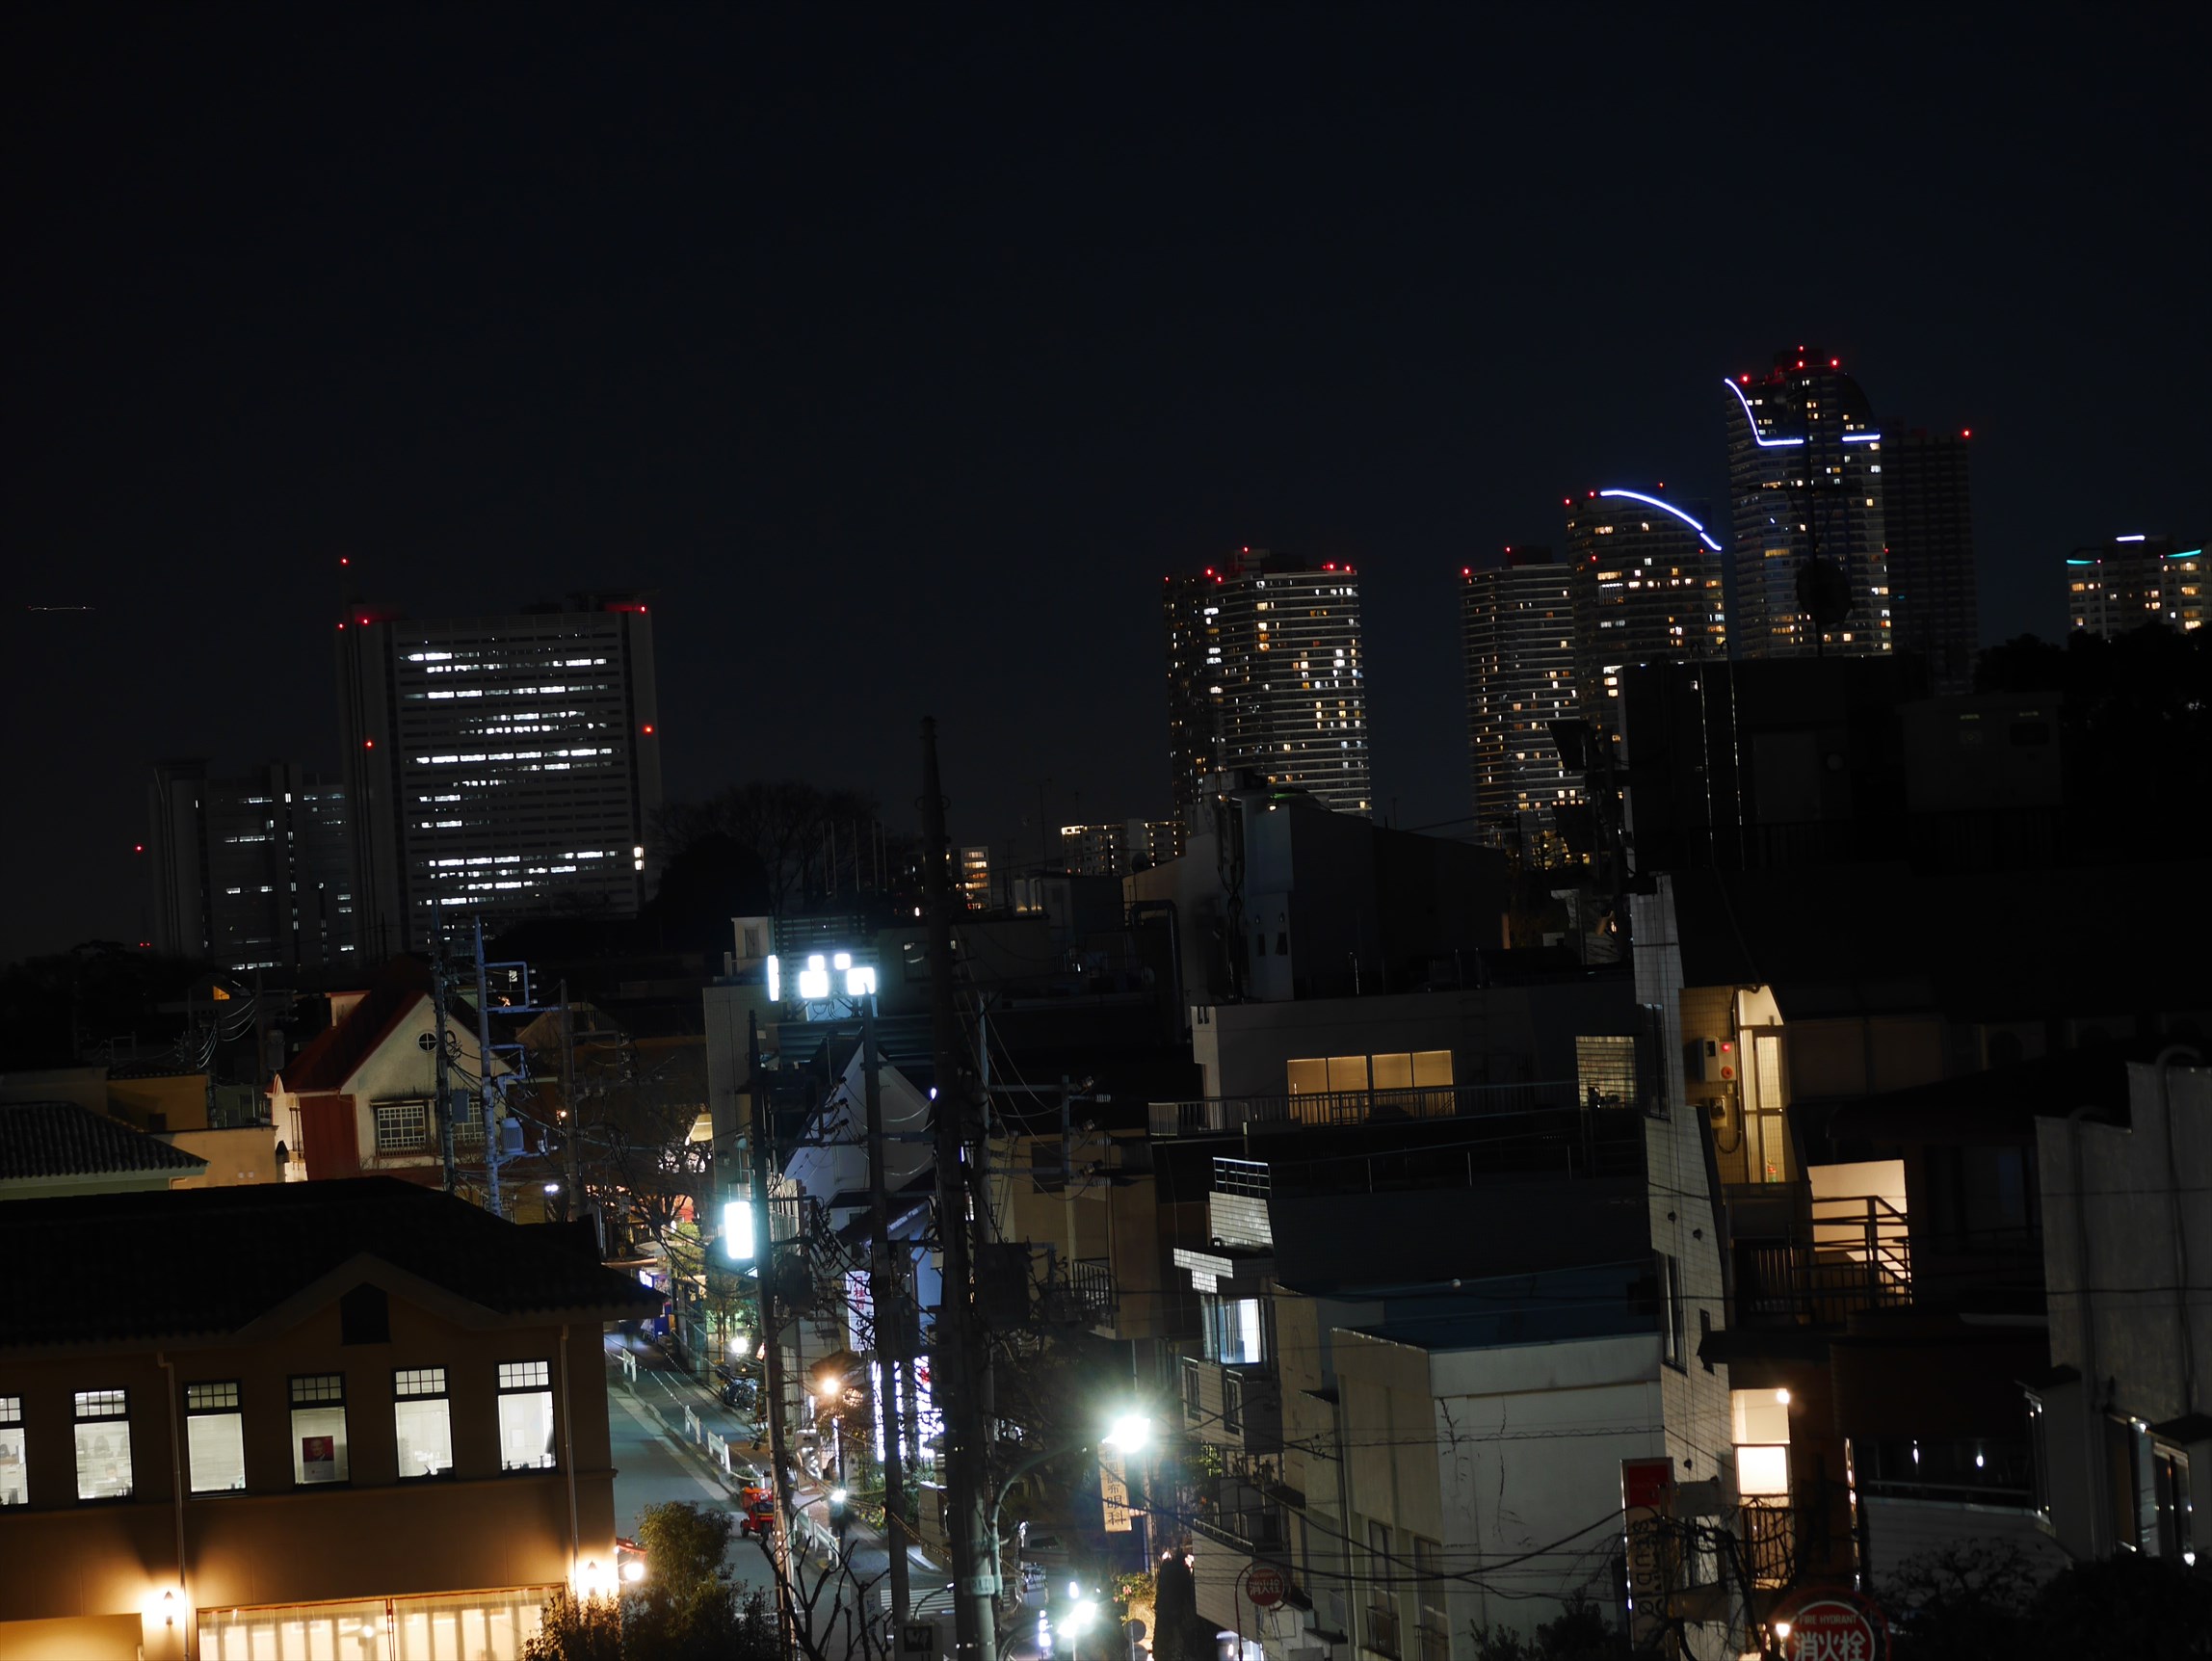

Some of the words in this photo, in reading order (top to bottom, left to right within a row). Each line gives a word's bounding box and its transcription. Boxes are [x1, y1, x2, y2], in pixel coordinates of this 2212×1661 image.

[1249, 1578, 1280, 1595] 消火栓
[1799, 1615, 1817, 1625] FIRE
[1820, 1614, 1857, 1625] HYDRANT
[1794, 1630, 1866, 1661] 消火栓
